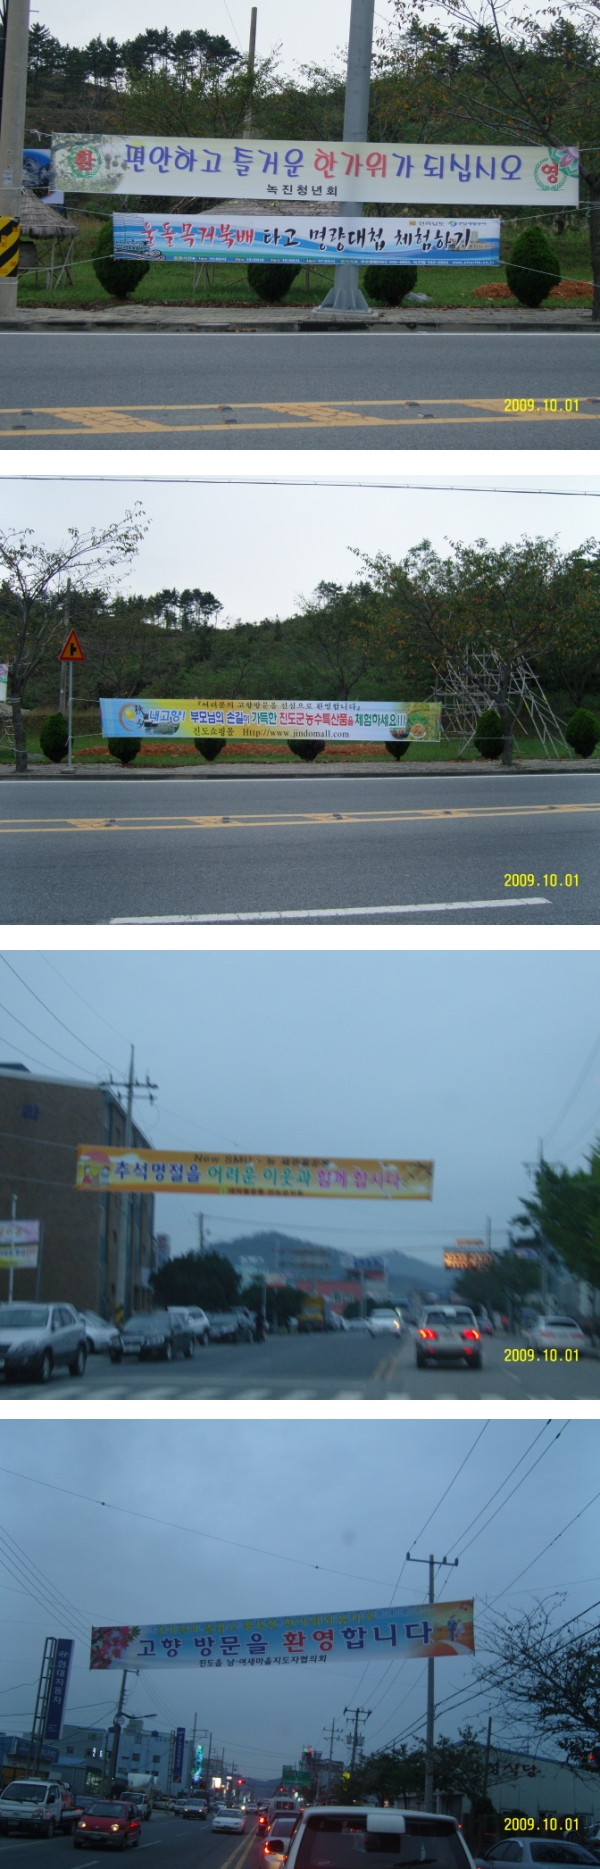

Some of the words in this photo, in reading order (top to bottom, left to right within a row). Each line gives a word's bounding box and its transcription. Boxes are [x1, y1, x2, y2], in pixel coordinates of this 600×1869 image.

[74, 149, 97, 171] 환
[125, 143, 222, 173] 편안하고
[233, 146, 304, 177] 즐거운
[313, 147, 414, 179] 한가위가
[423, 154, 522, 182] 되십시오
[541, 161, 559, 184] 영
[266, 184, 338, 197] 녹진청년회
[140, 221, 254, 249] 울돌목거북배
[263, 227, 300, 246] 타고
[309, 226, 386, 252] 명량대첩
[394, 227, 471, 251] 체험하기
[149, 710, 186, 723] 내고향!
[190, 710, 224, 725] 부모님의
[226, 711, 250, 725] 손길이
[251, 711, 277, 726] 가득한
[113, 1160, 201, 1185] 추석명절을
[207, 1164, 257, 1186] 어려운
[263, 1166, 312, 1188] 이웃과
[316, 1168, 348, 1189] 함께
[353, 1169, 401, 1191] 합시다
[137, 1637, 182, 1658] 고향
[193, 1632, 268, 1657] 방문을
[282, 1620, 433, 1653] 환영합니다
[199, 1658, 223, 1668] 진도읍
[52, 1660, 67, 1705] 현대자동차
